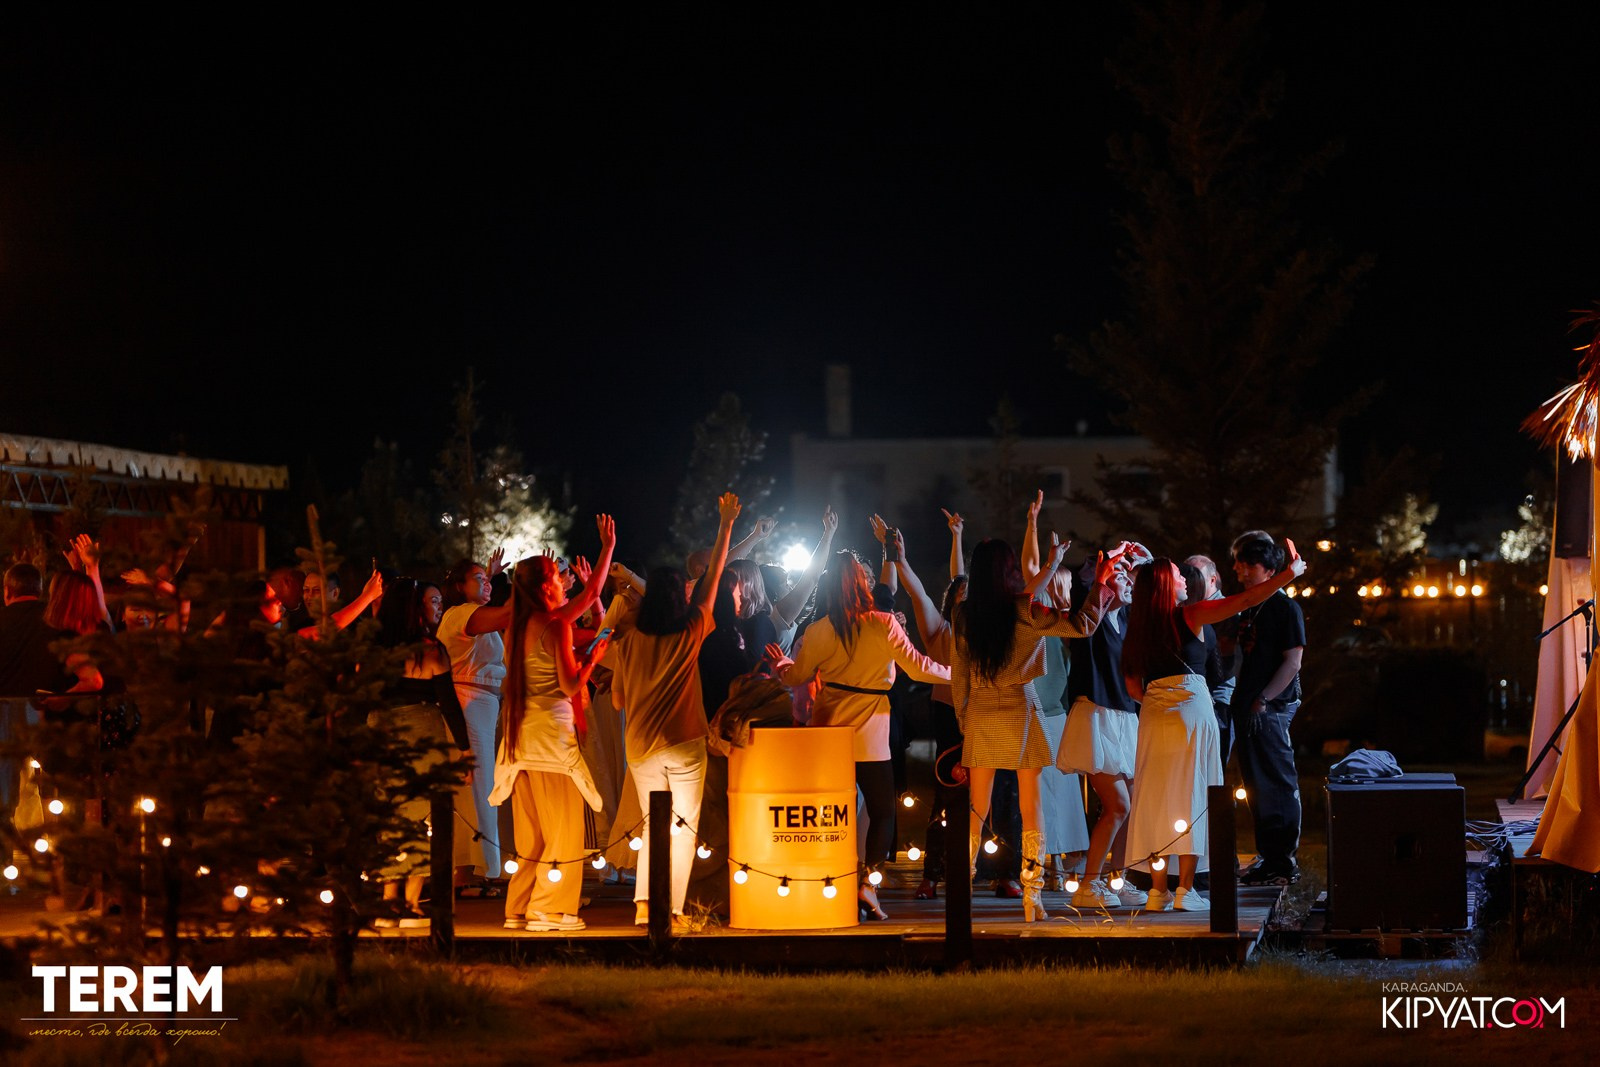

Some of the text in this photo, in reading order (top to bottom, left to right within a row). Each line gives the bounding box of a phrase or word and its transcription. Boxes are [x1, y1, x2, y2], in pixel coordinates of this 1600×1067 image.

[769, 804, 848, 828] TEREM
[772, 834, 792, 843] ЭТО
[793, 834, 808, 843] ПО
